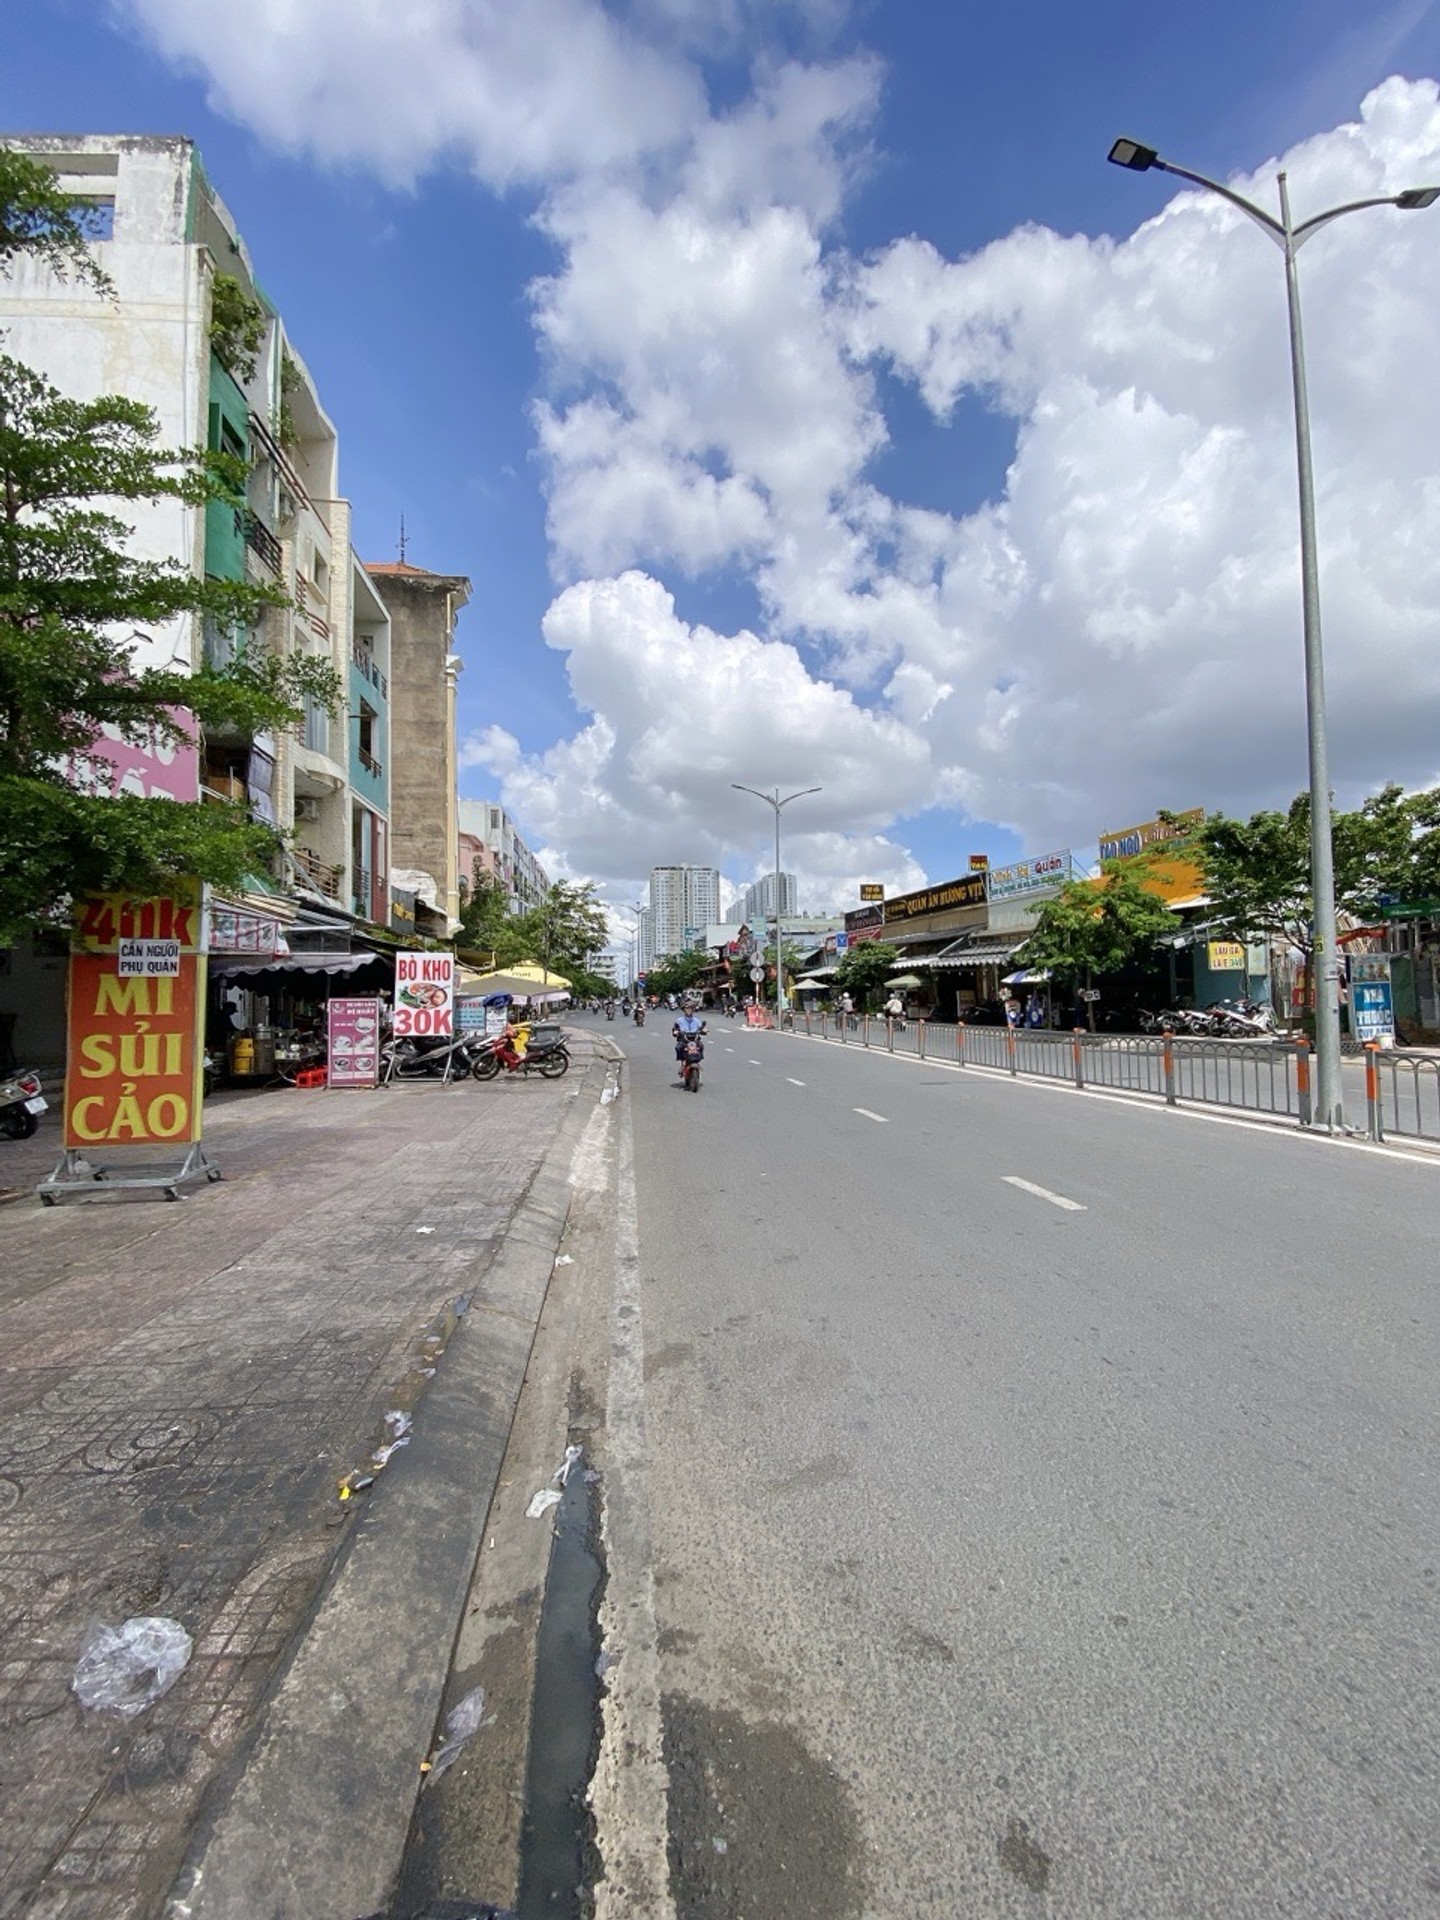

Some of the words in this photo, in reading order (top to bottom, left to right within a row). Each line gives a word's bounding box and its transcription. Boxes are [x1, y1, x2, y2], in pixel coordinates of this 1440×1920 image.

[121, 961, 143, 974] PHỤ
[147, 959, 178, 973] QUÁN
[399, 954, 417, 980] BÒ
[423, 960, 451, 980] KHO
[395, 1009, 452, 1034] 30K
[79, 1021, 183, 1078] SỦI
[72, 1083, 188, 1140] CẢO
